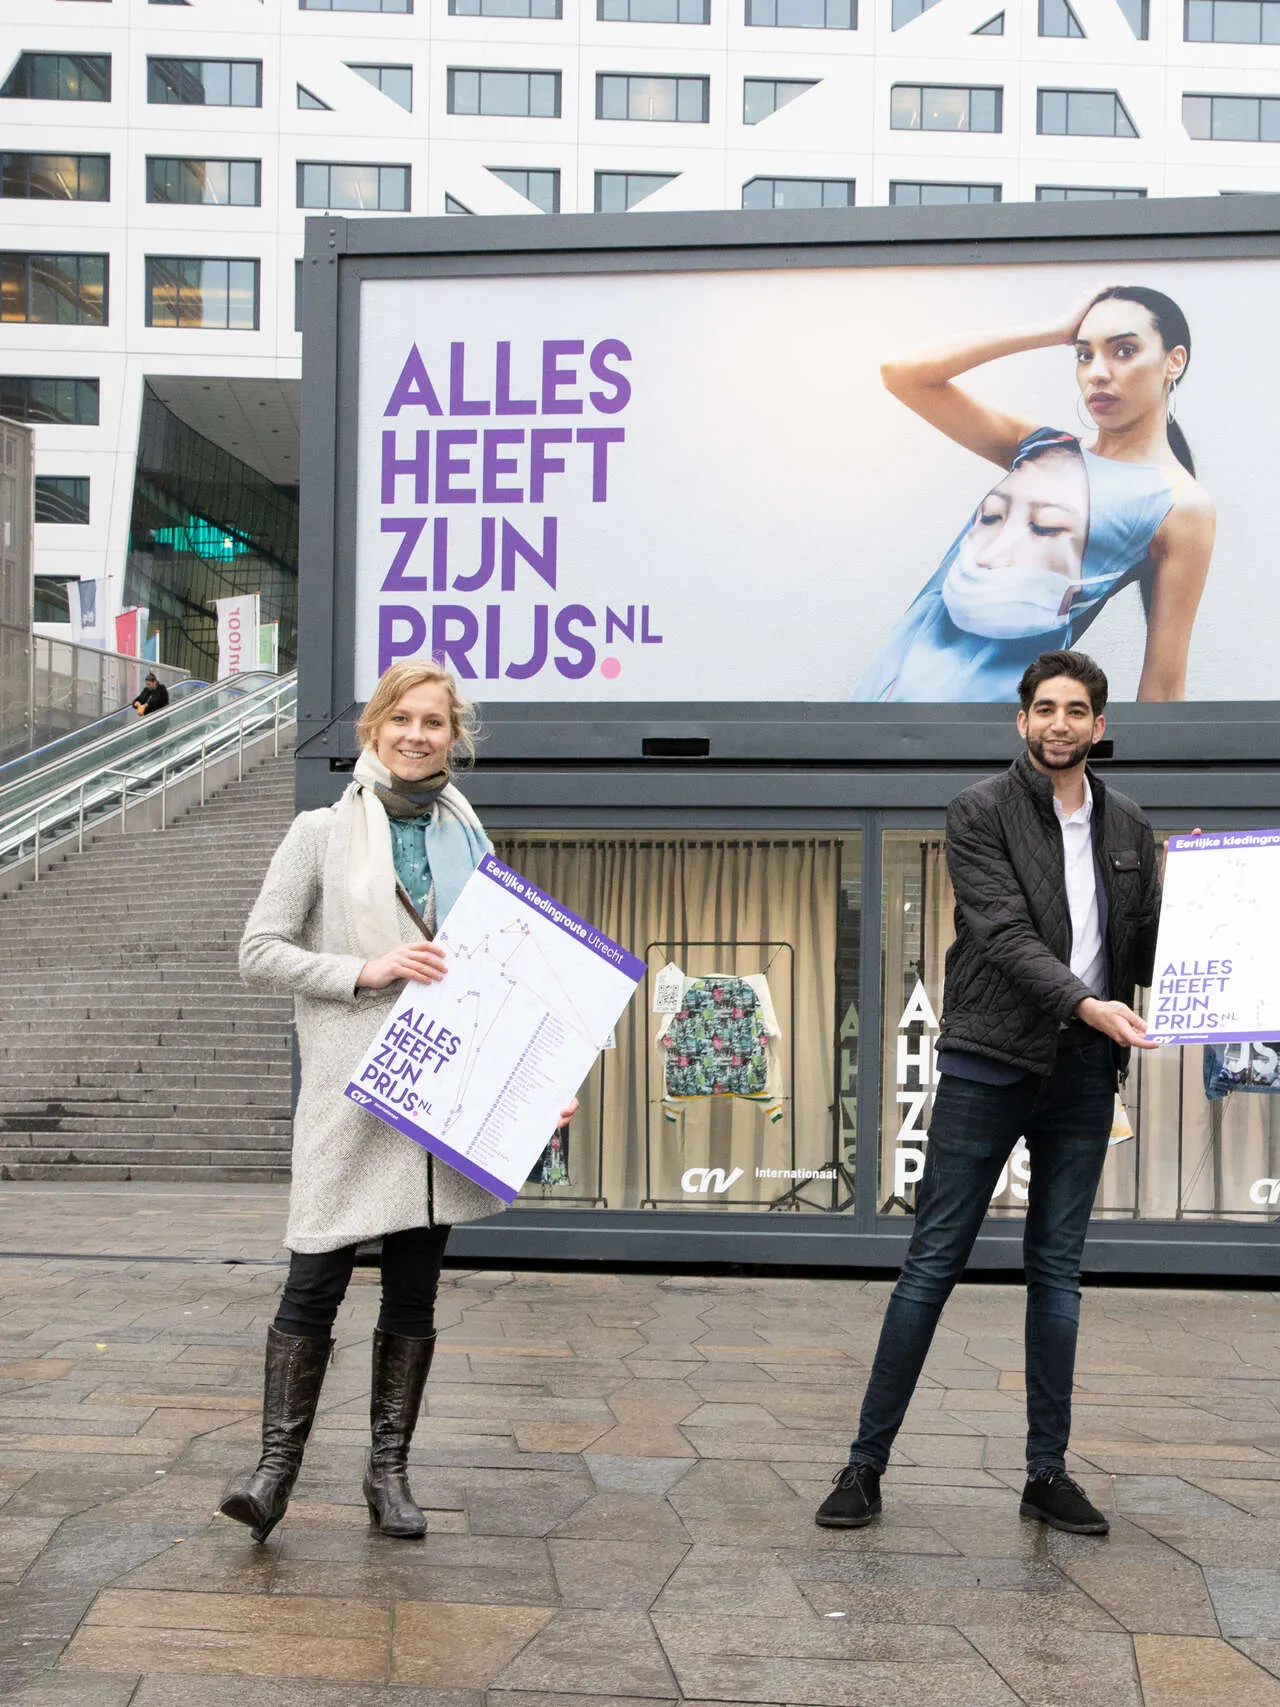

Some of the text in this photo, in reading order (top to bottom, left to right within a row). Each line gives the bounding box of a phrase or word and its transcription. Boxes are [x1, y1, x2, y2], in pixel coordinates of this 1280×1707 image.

[383, 338, 633, 416] ALLES
[381, 427, 626, 504] HEEFT
[380, 516, 558, 592] ZIJN
[1175, 836, 1220, 849] Eerlijke
[485, 860, 625, 965] Eerlijke kledingroute Utrecht
[1159, 977, 1230, 994] HEEFT
[1162, 959, 1233, 977] ALLES
[1158, 995, 1209, 1012] ZIJN
[384, 1022, 450, 1074] HEEFT
[396, 1007, 461, 1056] ALLES
[372, 1043, 423, 1087] ZIJN
[755, 1167, 838, 1181] Internationaal
